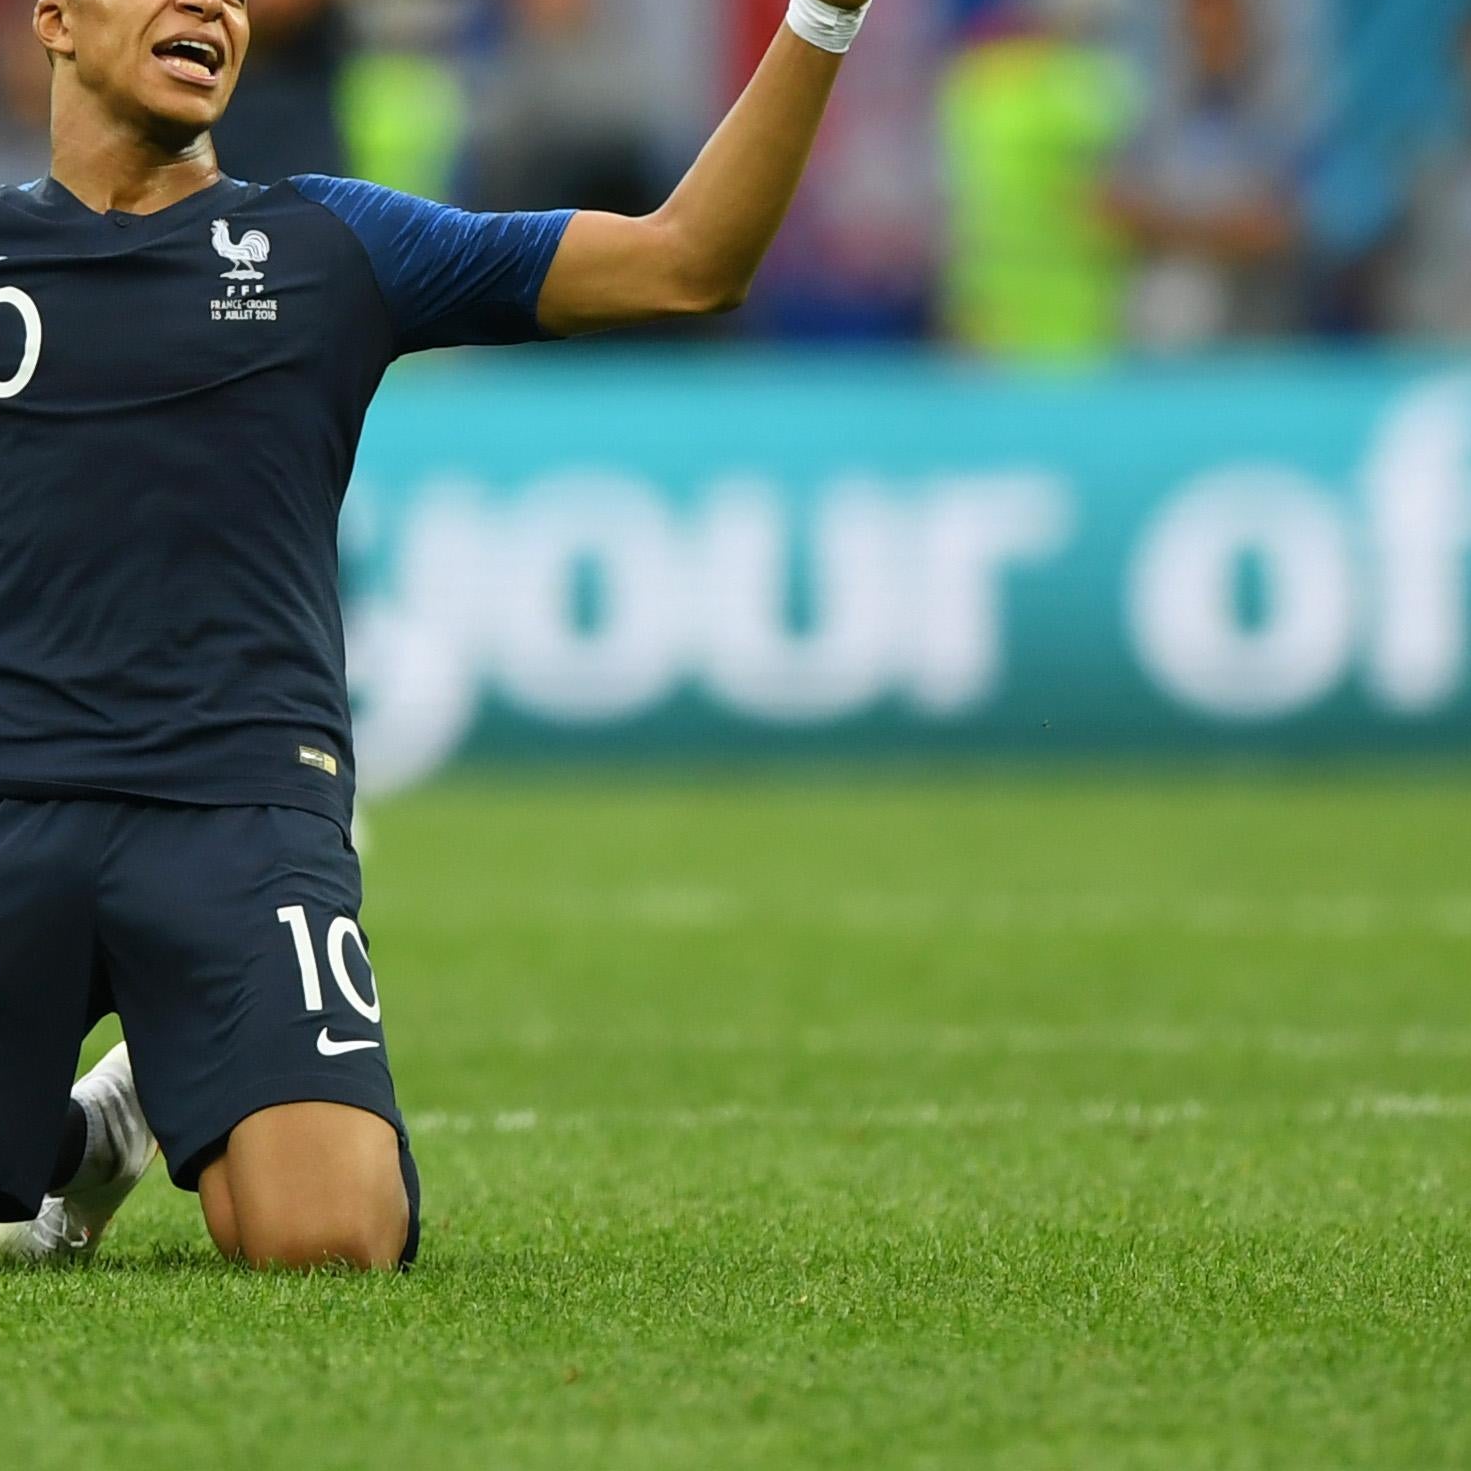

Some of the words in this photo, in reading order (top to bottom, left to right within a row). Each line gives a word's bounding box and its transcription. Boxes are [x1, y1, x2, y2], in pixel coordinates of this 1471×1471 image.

[211, 310, 222, 320] 15
[224, 310, 253, 320] JUILLET
[255, 310, 277, 320] 2018
[276, 904, 381, 1024] 10
